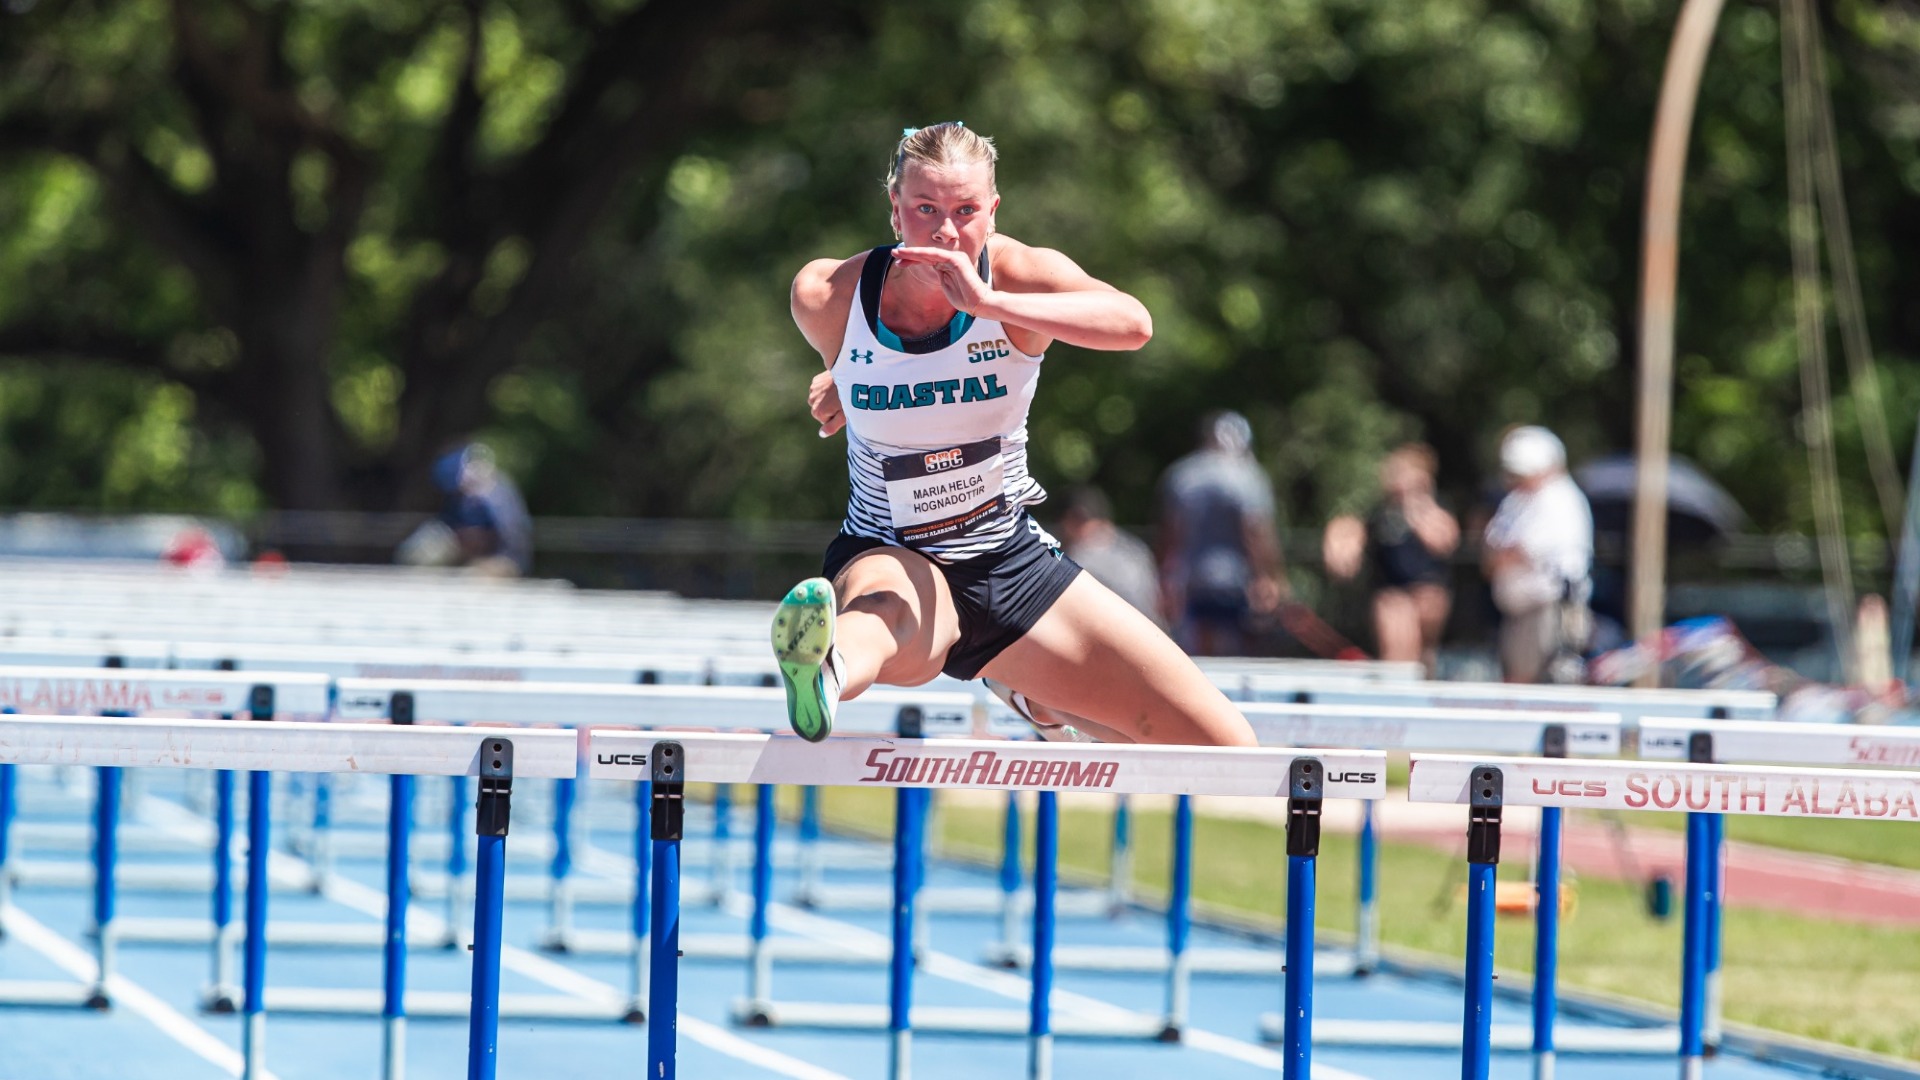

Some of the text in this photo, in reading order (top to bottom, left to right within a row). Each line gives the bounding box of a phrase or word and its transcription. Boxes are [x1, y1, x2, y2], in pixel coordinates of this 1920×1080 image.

[967, 338, 1010, 363] SBC
[851, 373, 1008, 411] COASTAL
[924, 448, 964, 473] SBC
[913, 474, 983, 499] MARIA HELGA
[913, 485, 985, 513] HOGNADOTTIR
[904, 532, 929, 541] MOBILE
[929, 524, 957, 536] ALABAMA
[597, 753, 647, 766] UCS
[1327, 771, 1377, 784] UCS
[1532, 772, 1920, 818] UCS SOUTH ALABA
